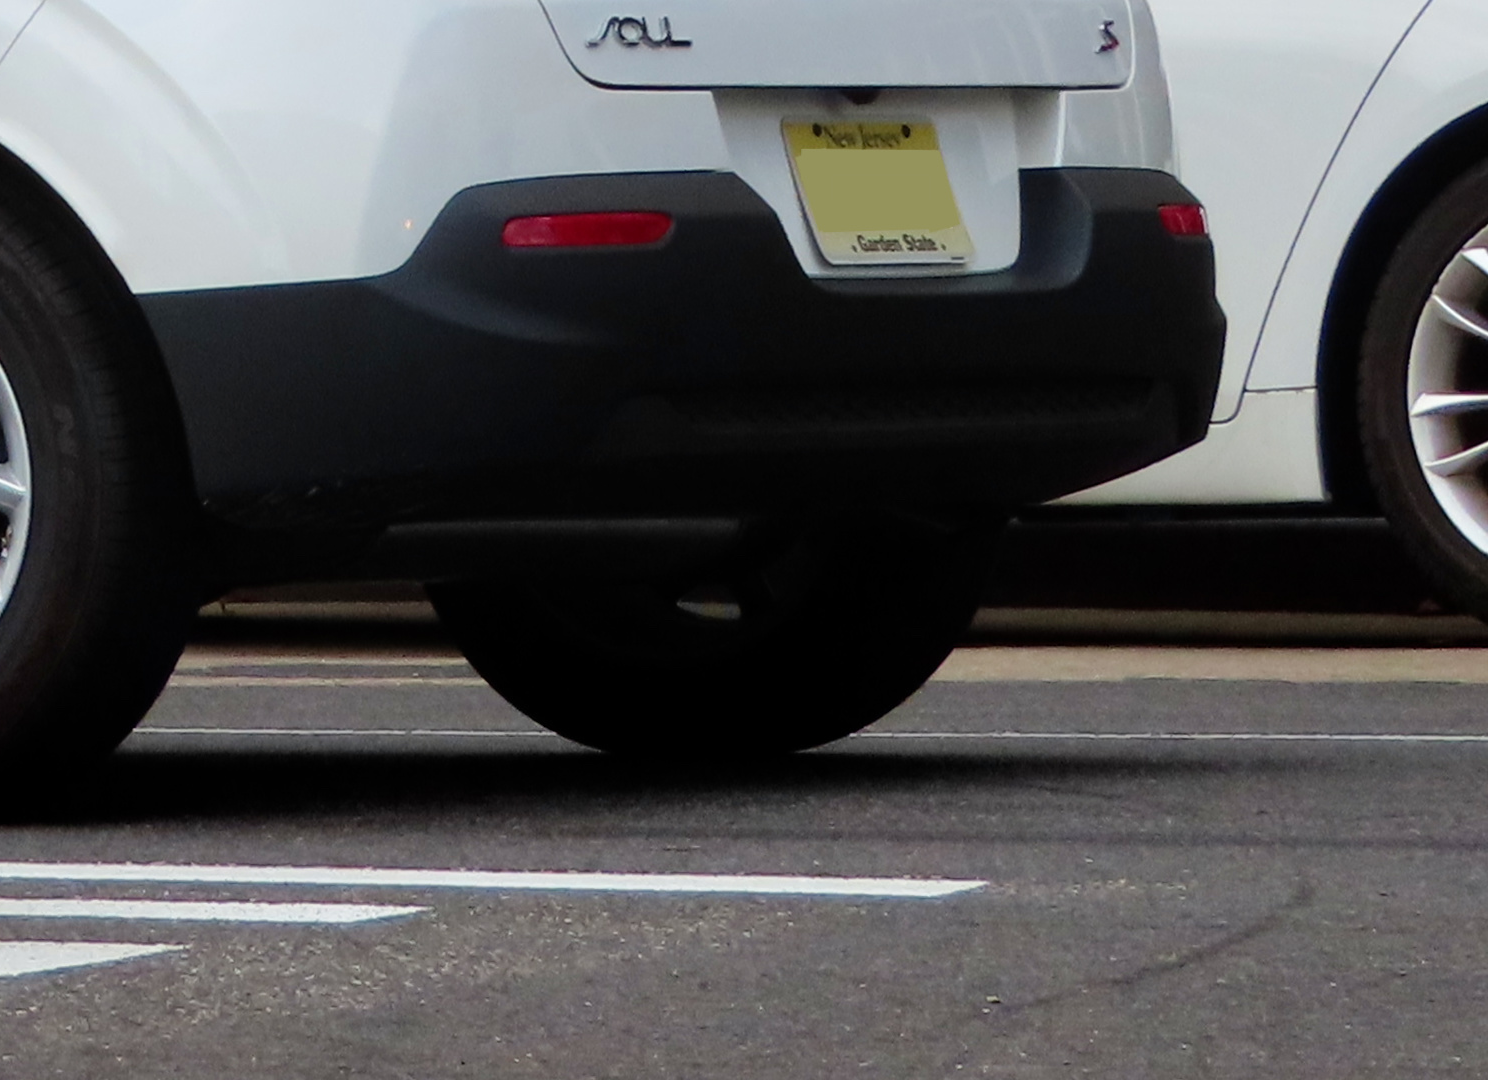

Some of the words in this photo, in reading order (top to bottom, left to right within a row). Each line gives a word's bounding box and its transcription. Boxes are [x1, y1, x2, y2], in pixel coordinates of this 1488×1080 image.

[585, 16, 693, 49] SOUL
[859, 123, 902, 150] Jersey
[857, 234, 901, 253] Garden
[903, 233, 939, 252] State
